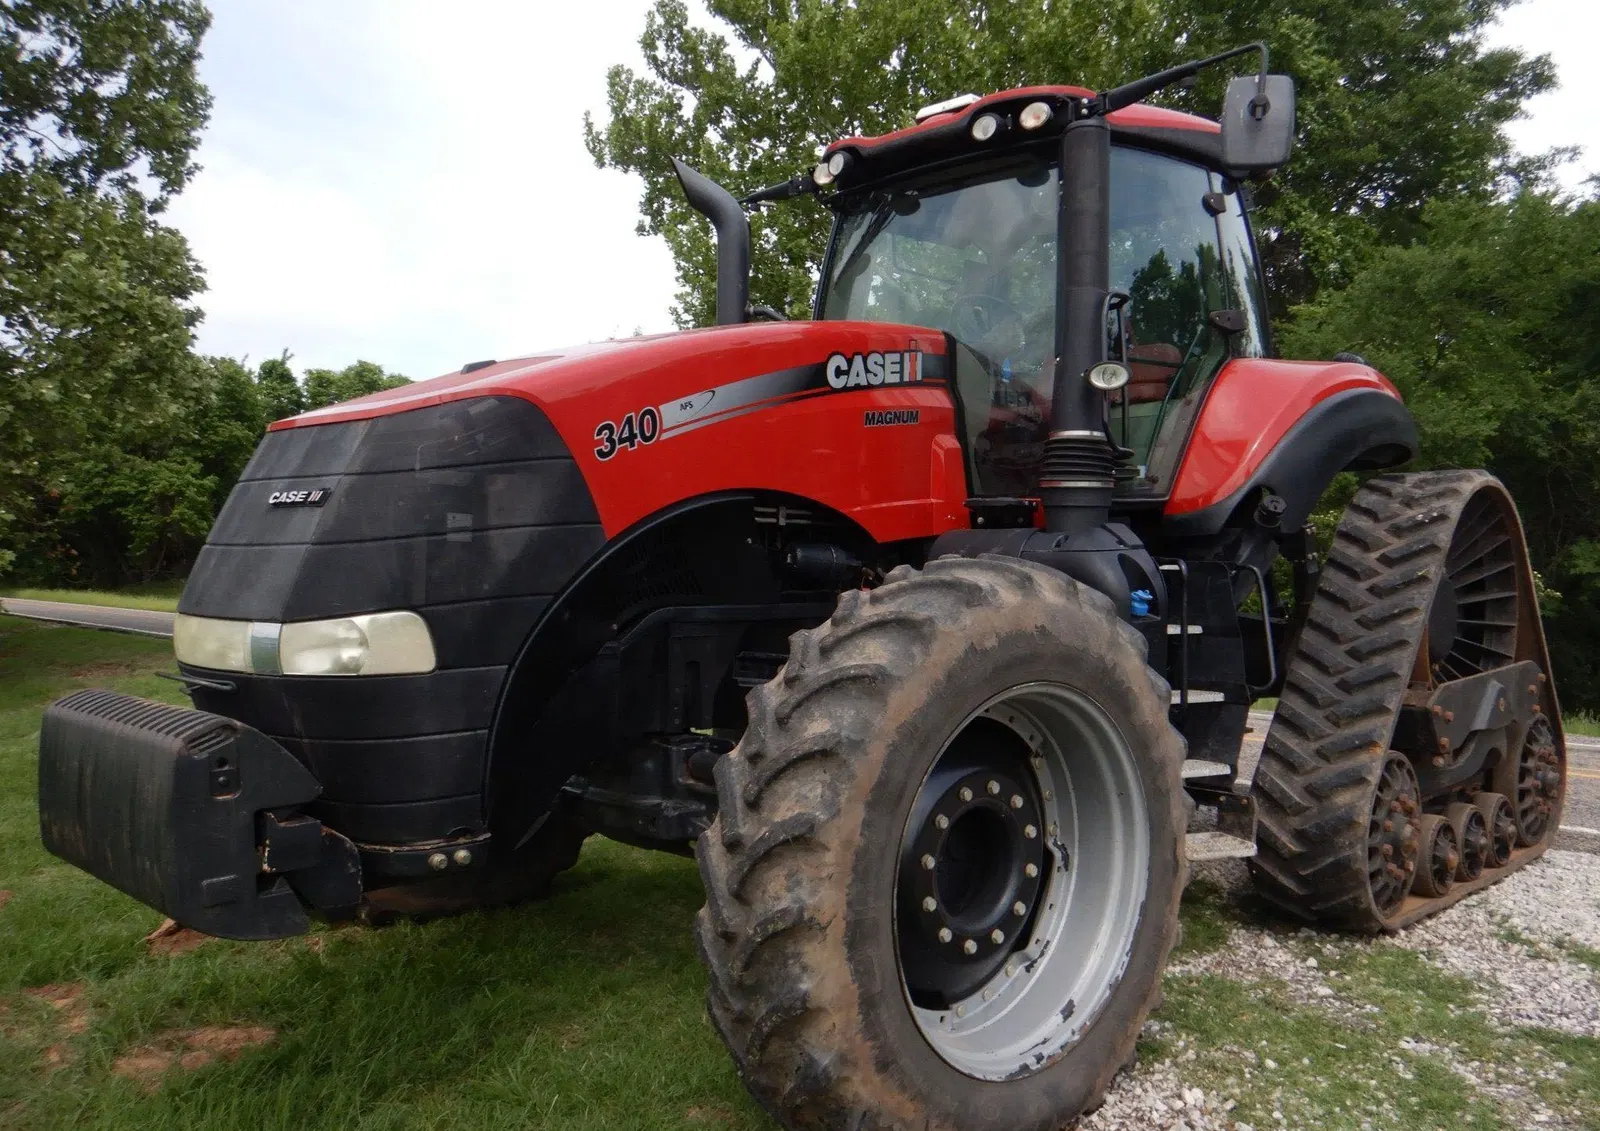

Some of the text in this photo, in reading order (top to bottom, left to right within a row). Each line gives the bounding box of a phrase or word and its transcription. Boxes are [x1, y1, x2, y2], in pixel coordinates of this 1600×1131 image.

[826, 351, 900, 389] CASE
[679, 401, 694, 411] AFS
[864, 409, 919, 427] MAGNUM
[594, 406, 660, 462] 340
[268, 491, 308, 504] CASE
